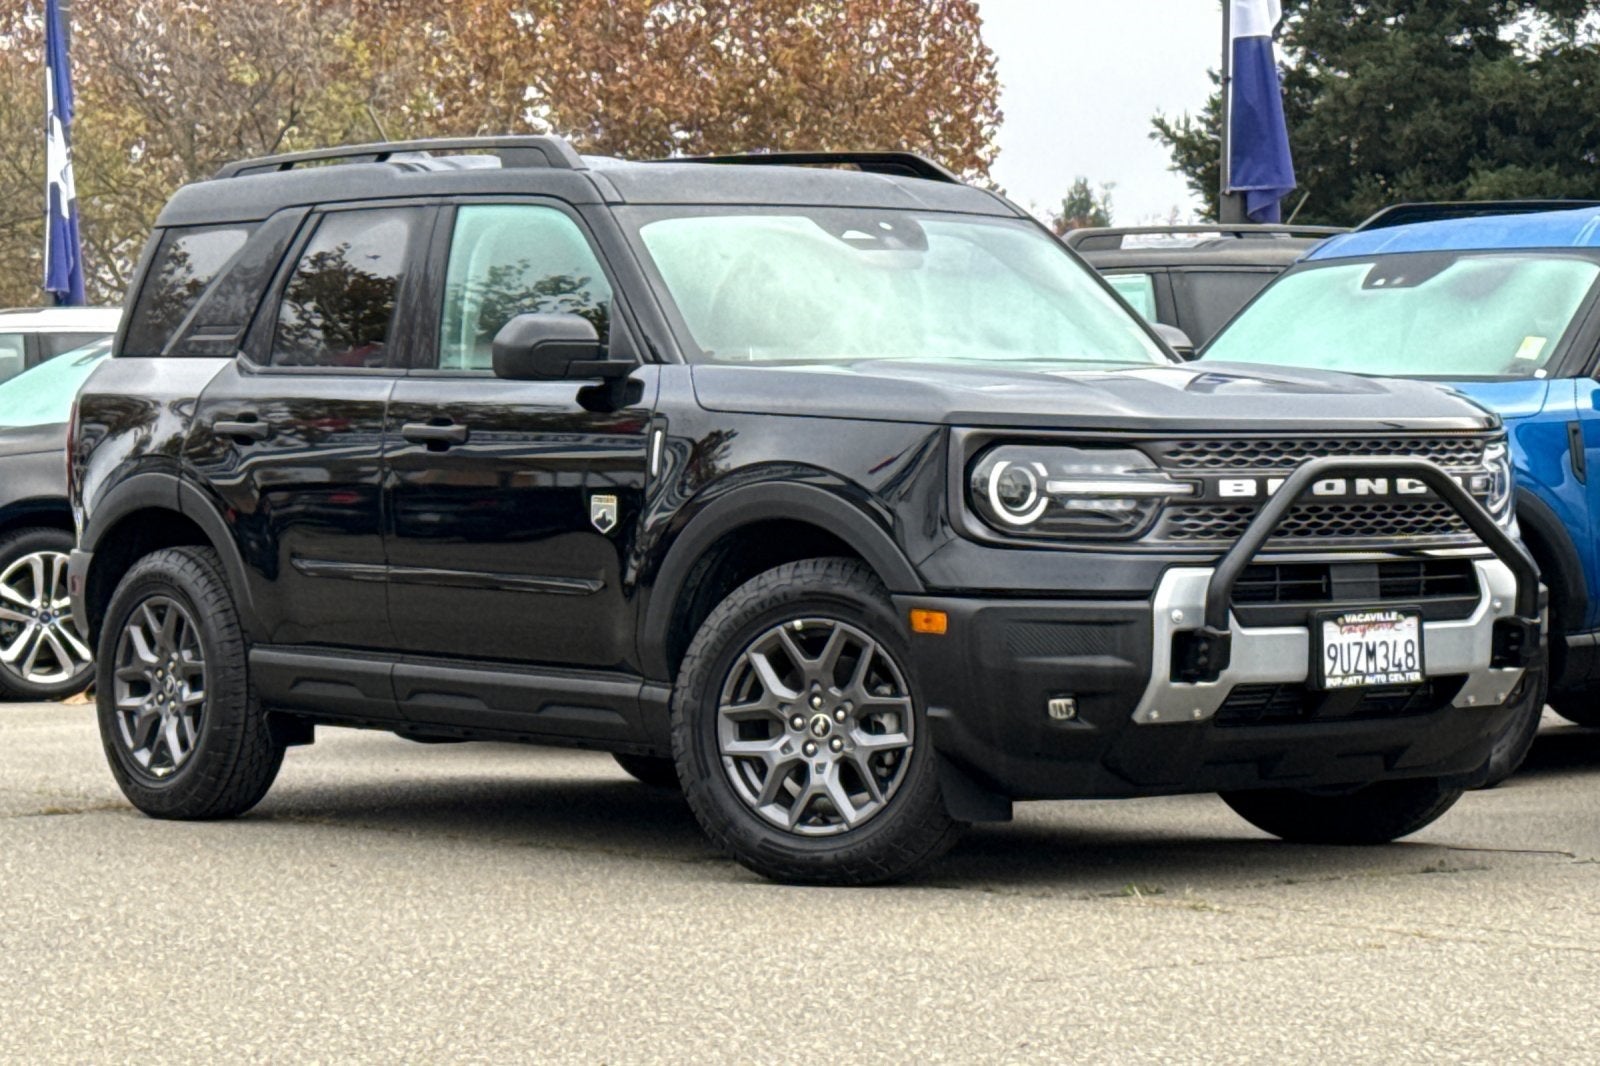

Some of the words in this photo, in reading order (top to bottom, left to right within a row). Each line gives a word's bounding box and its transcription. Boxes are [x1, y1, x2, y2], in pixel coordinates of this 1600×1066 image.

[1218, 477, 1462, 497] BONC
[1345, 612, 1398, 622] VACAVILLE
[1327, 639, 1416, 677] 9UZM348
